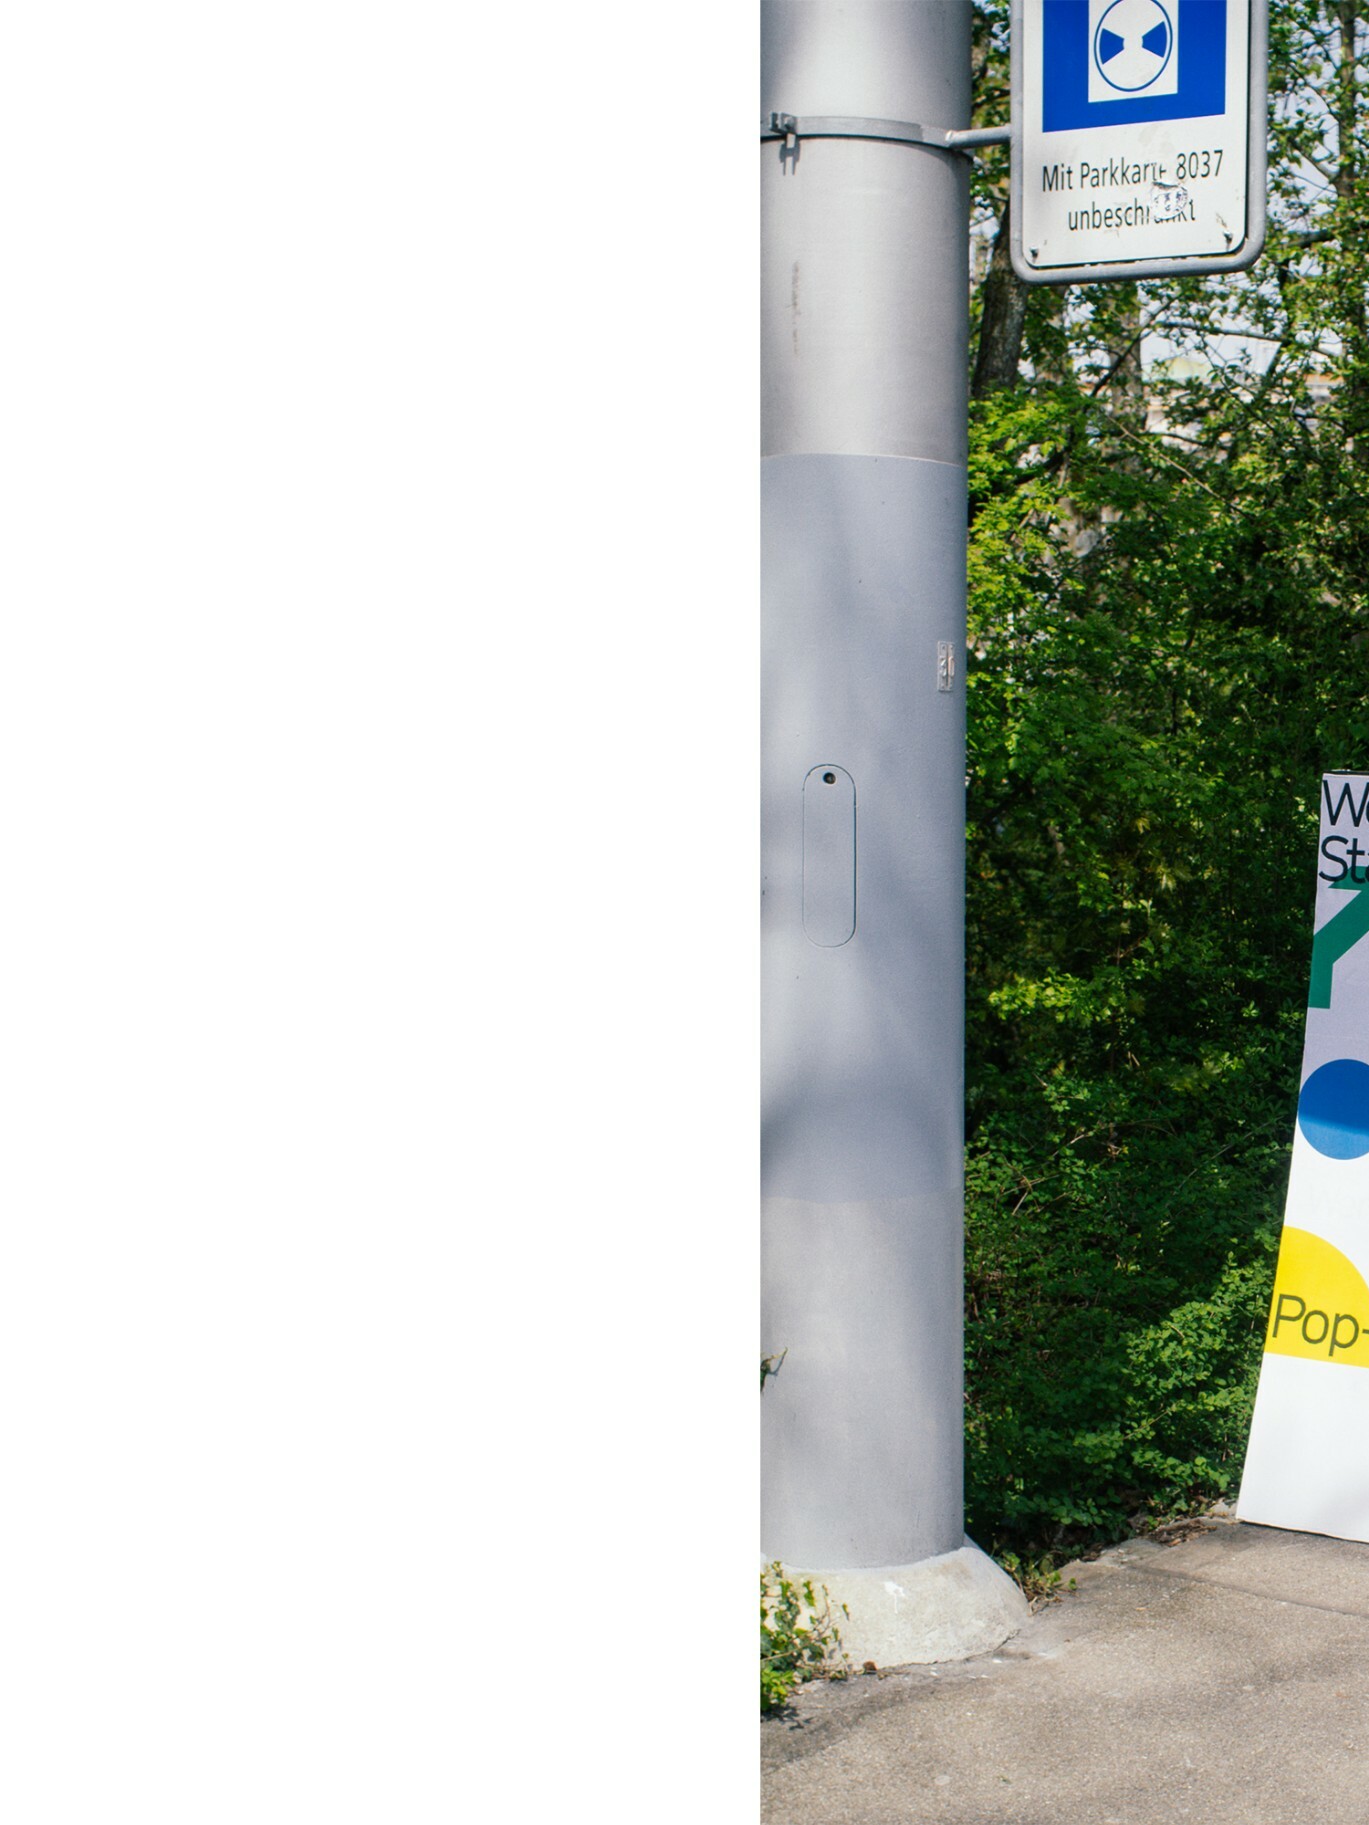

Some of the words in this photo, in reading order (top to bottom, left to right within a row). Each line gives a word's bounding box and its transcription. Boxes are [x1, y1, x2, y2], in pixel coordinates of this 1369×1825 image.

[1042, 163, 1073, 192] Mit
[1176, 149, 1224, 180] 8037
[1068, 198, 1196, 231] unbeschrt
